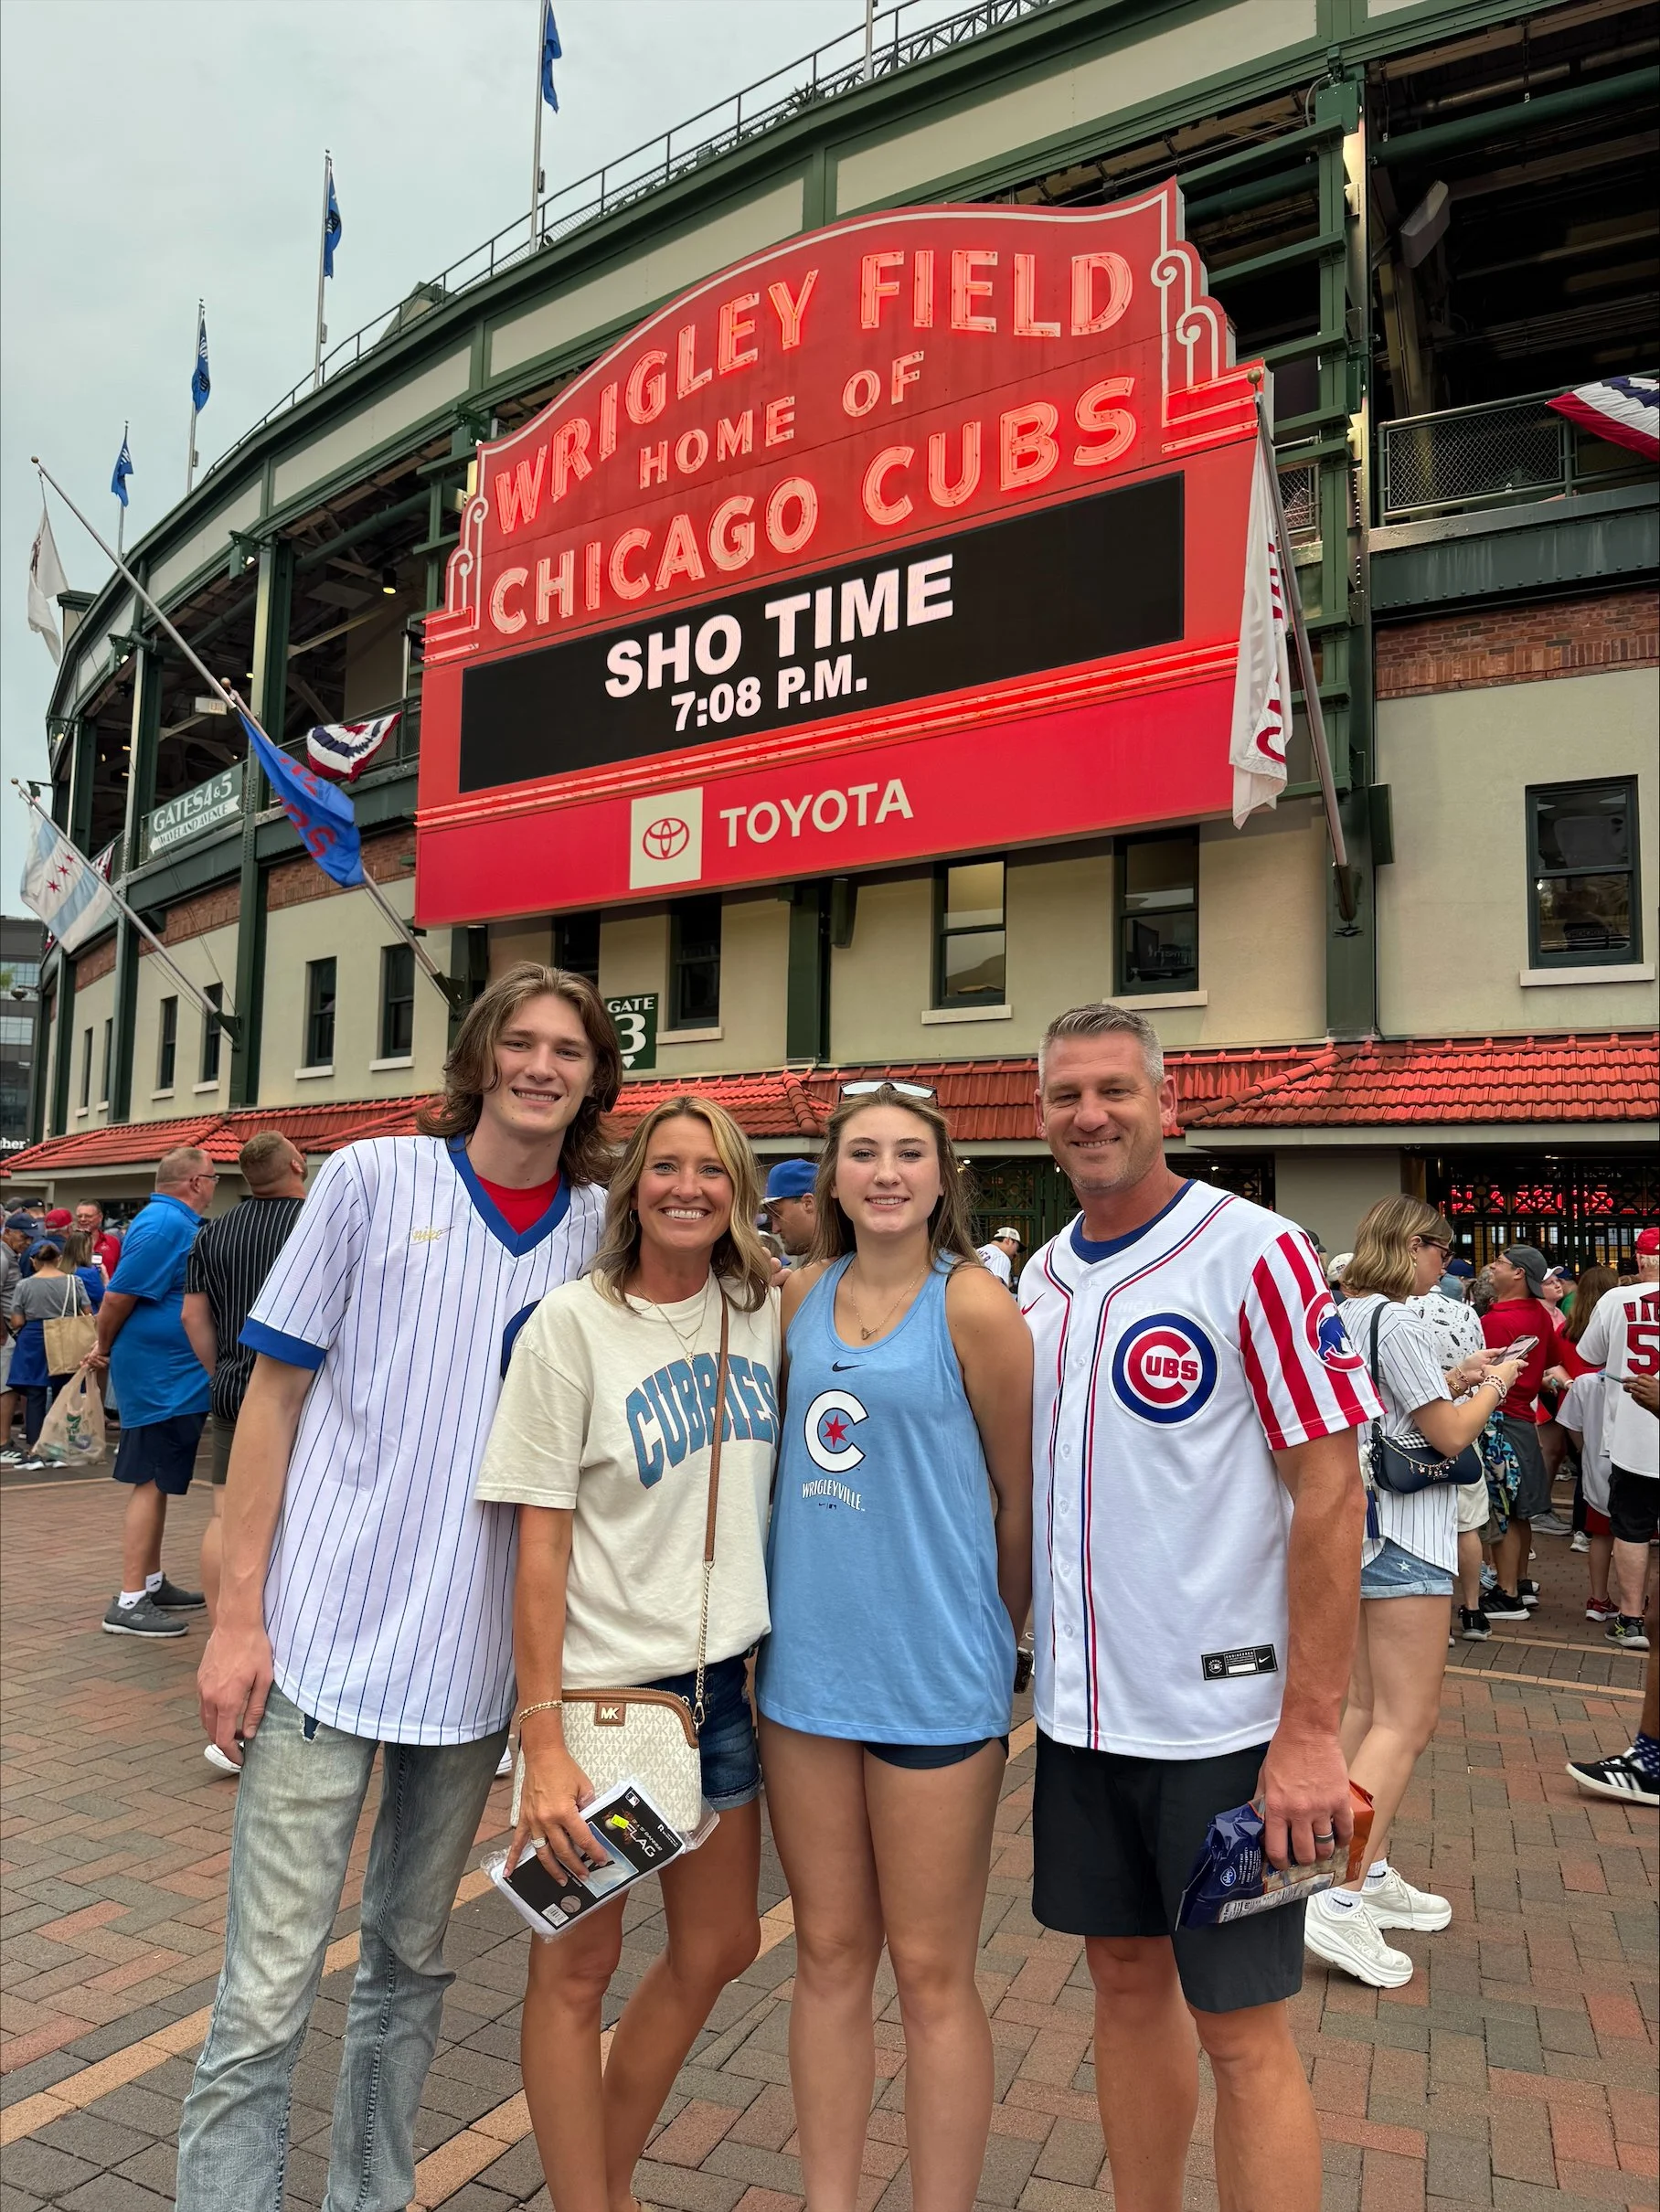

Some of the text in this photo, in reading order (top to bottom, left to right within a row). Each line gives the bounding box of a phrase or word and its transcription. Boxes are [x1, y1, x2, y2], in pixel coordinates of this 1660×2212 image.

[494, 248, 1134, 535] WRIGLEY FIELD
[638, 349, 925, 490] HOME OF
[488, 376, 1138, 636] CHICAGO CUBS
[604, 553, 954, 700] SHO TIME
[670, 654, 869, 733] 7:08 P.M.
[159, 803, 229, 845] WAVELAND AVENUE
[719, 778, 916, 849] TOYOTA
[607, 996, 655, 1014] GATE
[614, 1013, 647, 1055] 3
[1627, 1324, 1659, 1377] 5
[803, 1388, 870, 1473] C
[802, 1478, 862, 1511] WRIGLEYVILLE
[601, 1707, 620, 1719] MK
[626, 1823, 656, 1857] FLAG
